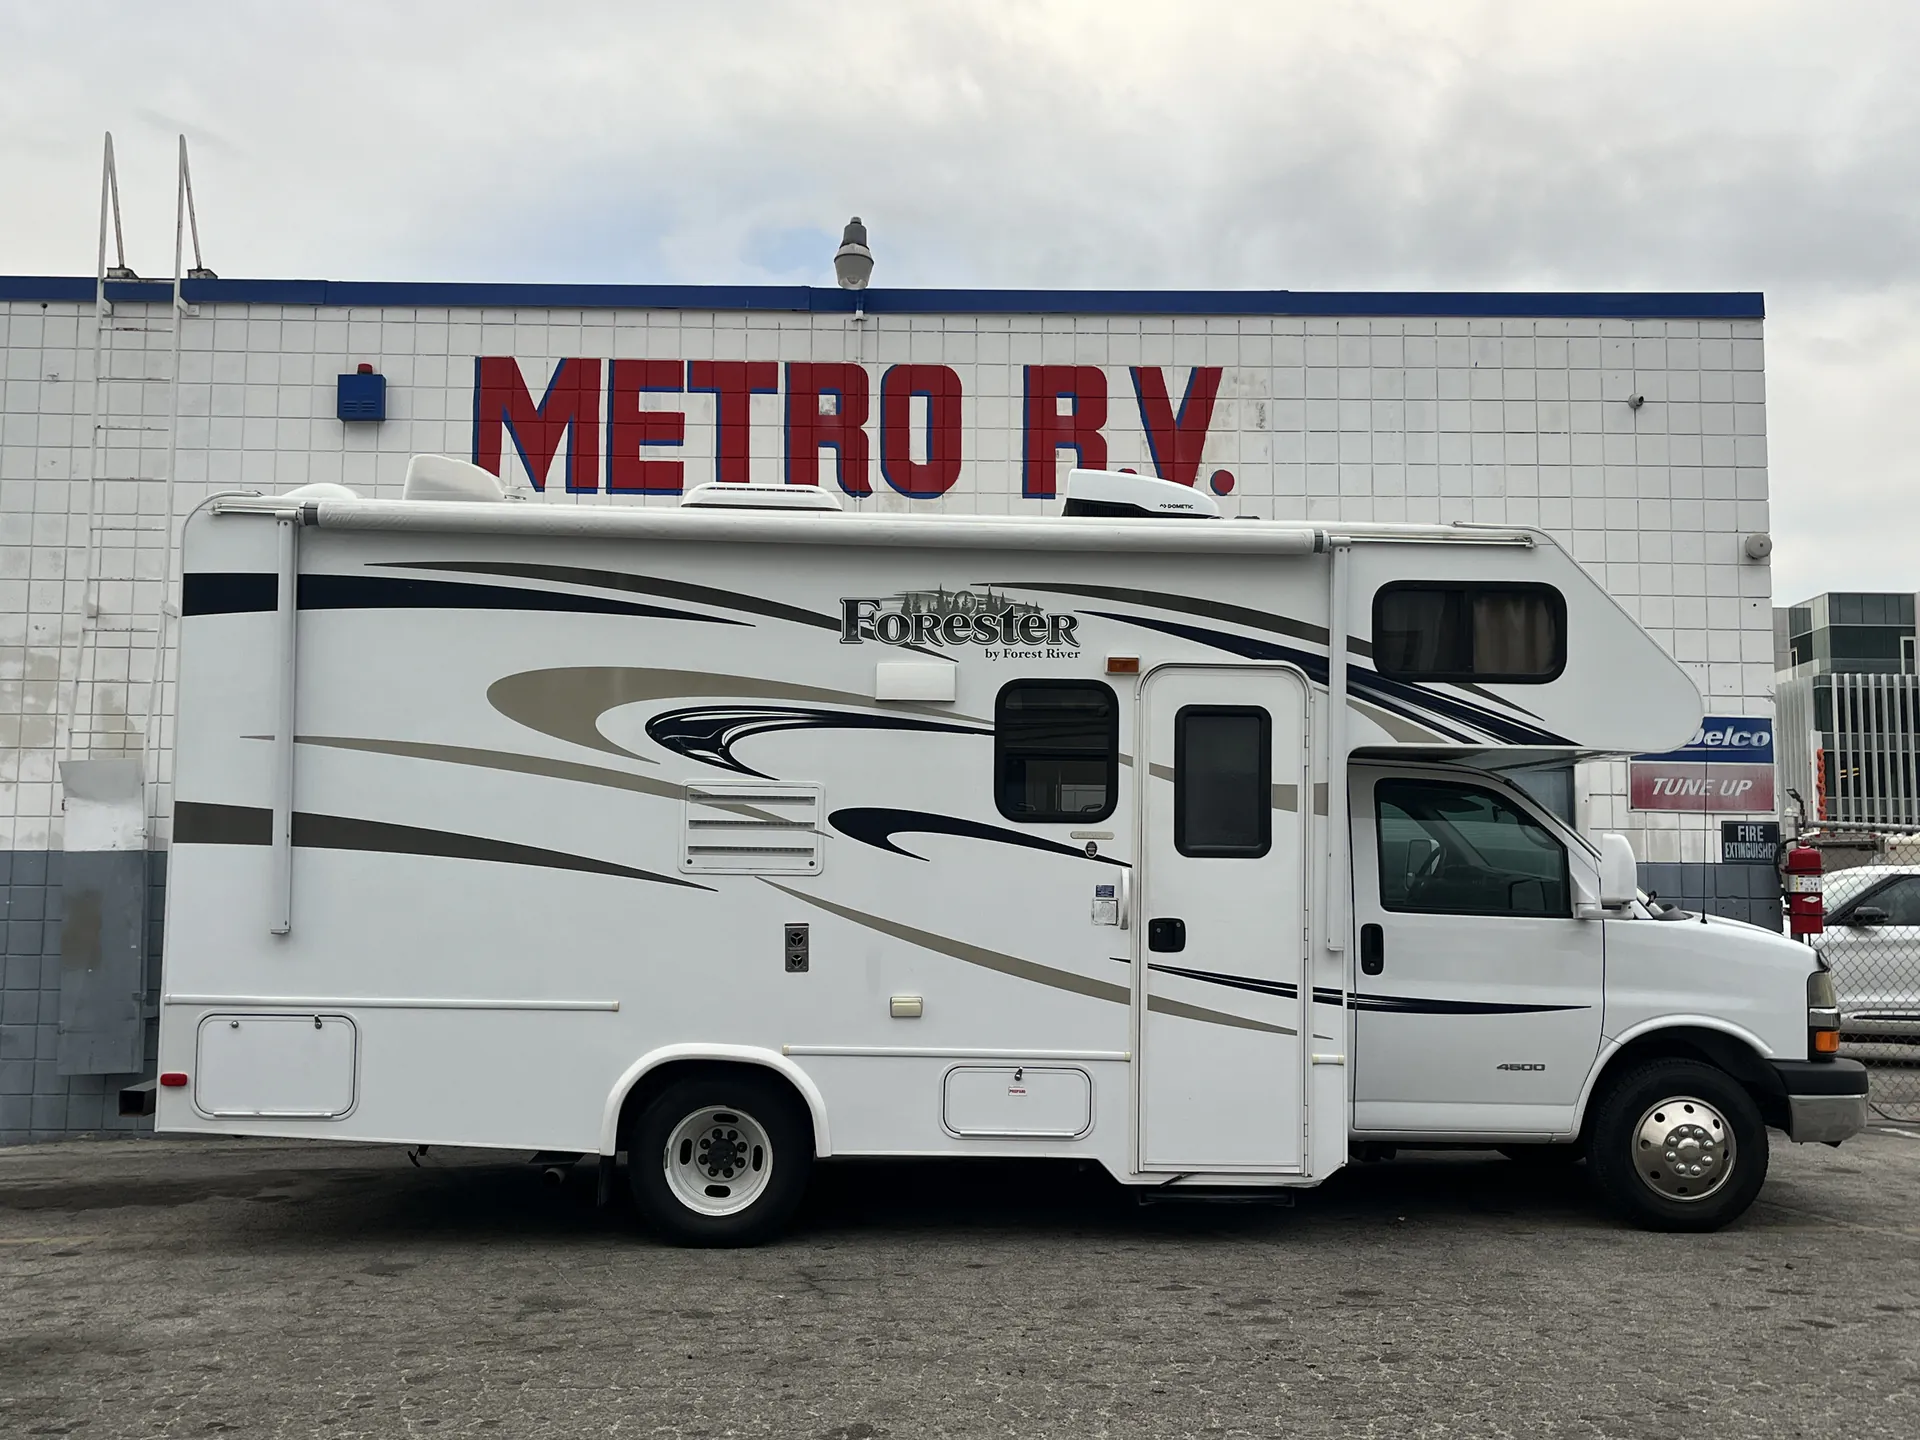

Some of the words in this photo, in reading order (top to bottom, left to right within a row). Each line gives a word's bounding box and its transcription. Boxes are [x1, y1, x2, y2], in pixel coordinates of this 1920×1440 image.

[472, 356, 961, 498] METRO
[985, 649, 1000, 661] by
[1004, 649, 1043, 659] Forest
[1047, 649, 1080, 659] River
[1652, 778, 1715, 796] TUNE
[1720, 779, 1753, 796] UP
[1737, 825, 1764, 842] FIRE
[1496, 1063, 1546, 1071] 4500
